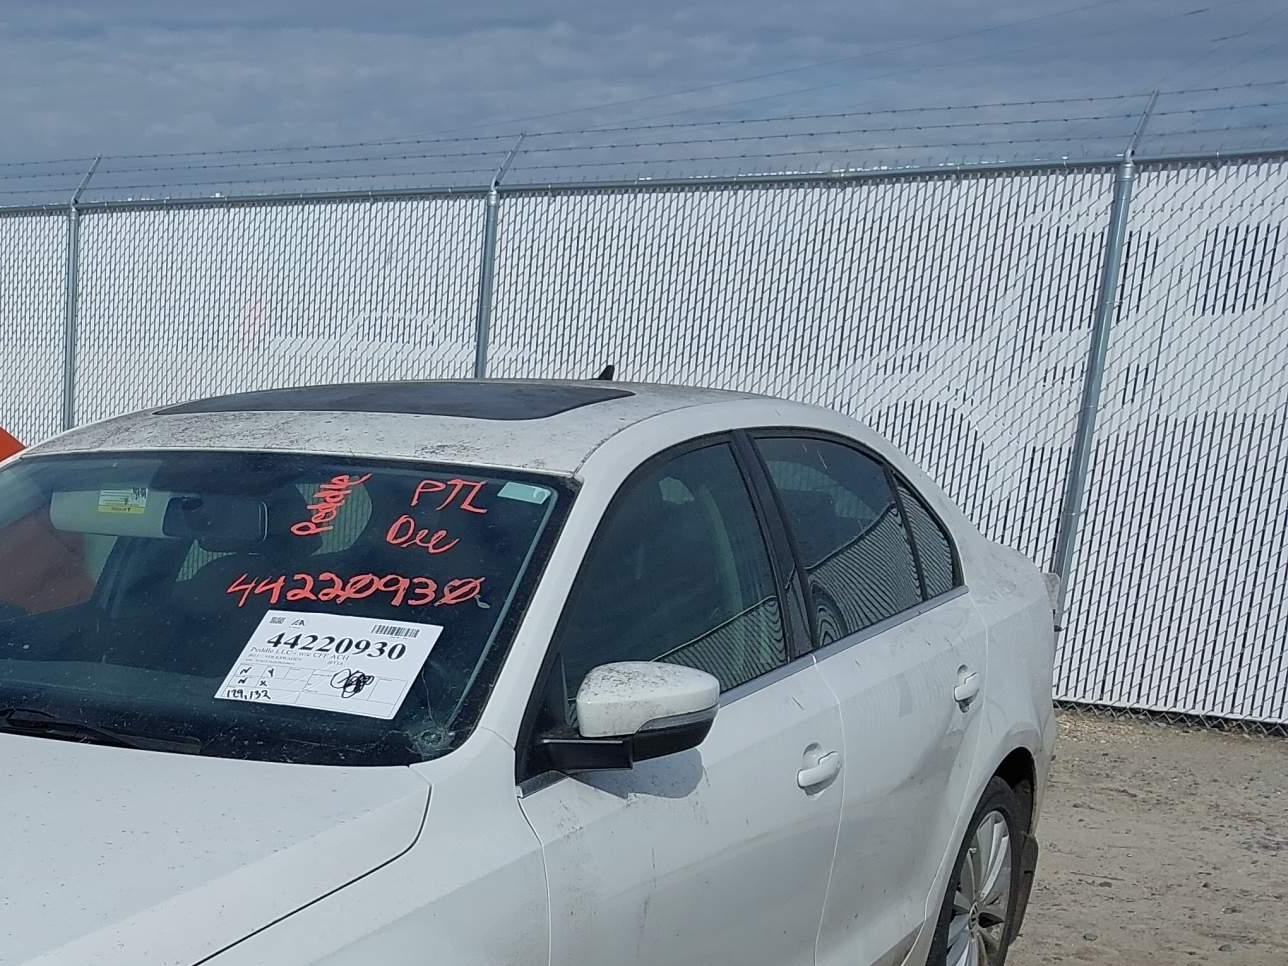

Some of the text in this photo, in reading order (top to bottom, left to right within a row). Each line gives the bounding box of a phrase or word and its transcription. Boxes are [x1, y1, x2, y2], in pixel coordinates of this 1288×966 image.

[411, 478, 488, 513] PTL
[226, 571, 486, 607] 44220930
[266, 631, 407, 661] 44220930
